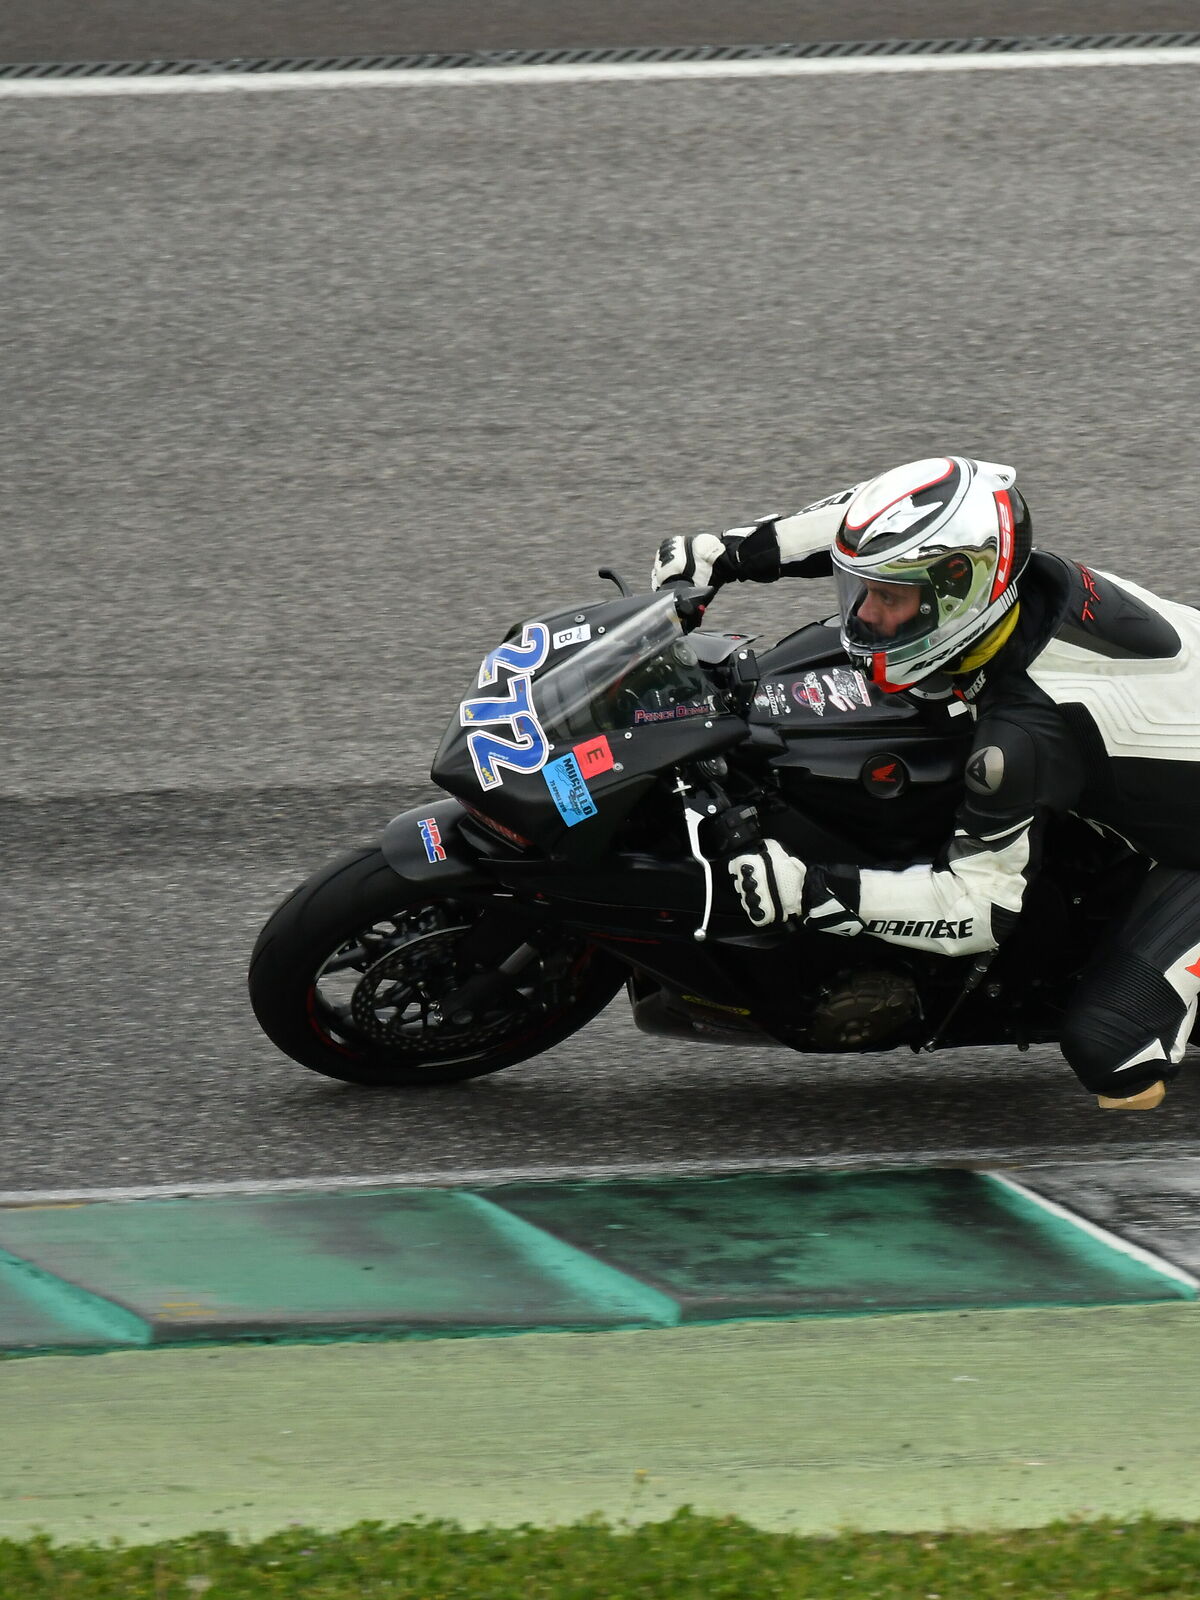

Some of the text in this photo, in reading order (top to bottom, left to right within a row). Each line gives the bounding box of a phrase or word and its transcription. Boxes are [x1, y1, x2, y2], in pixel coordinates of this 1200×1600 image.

[559, 632, 572, 643] B
[765, 685, 779, 716] BIZZOTTO
[587, 747, 604, 763] E
[563, 758, 592, 815] MUGELLO
[417, 817, 446, 863] HRC
